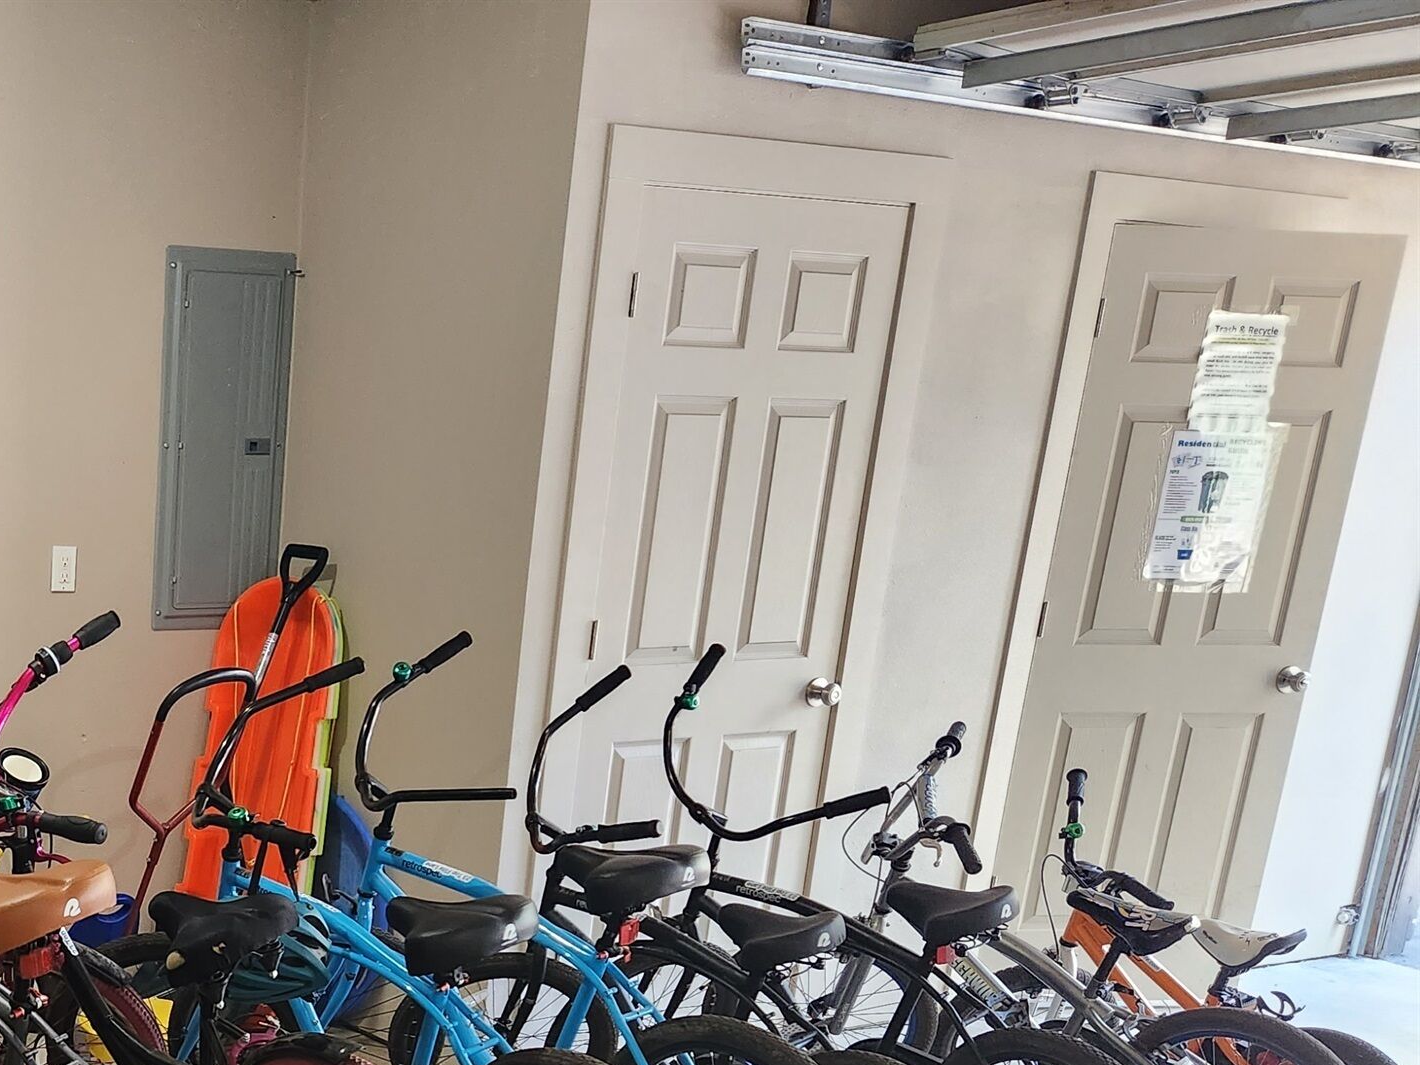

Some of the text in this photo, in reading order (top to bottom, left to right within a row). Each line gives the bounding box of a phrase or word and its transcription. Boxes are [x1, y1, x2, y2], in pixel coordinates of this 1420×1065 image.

[1248, 326, 1279, 336] Recycle
[1177, 440, 1226, 448] Residential
[735, 885, 781, 903] retrospec
